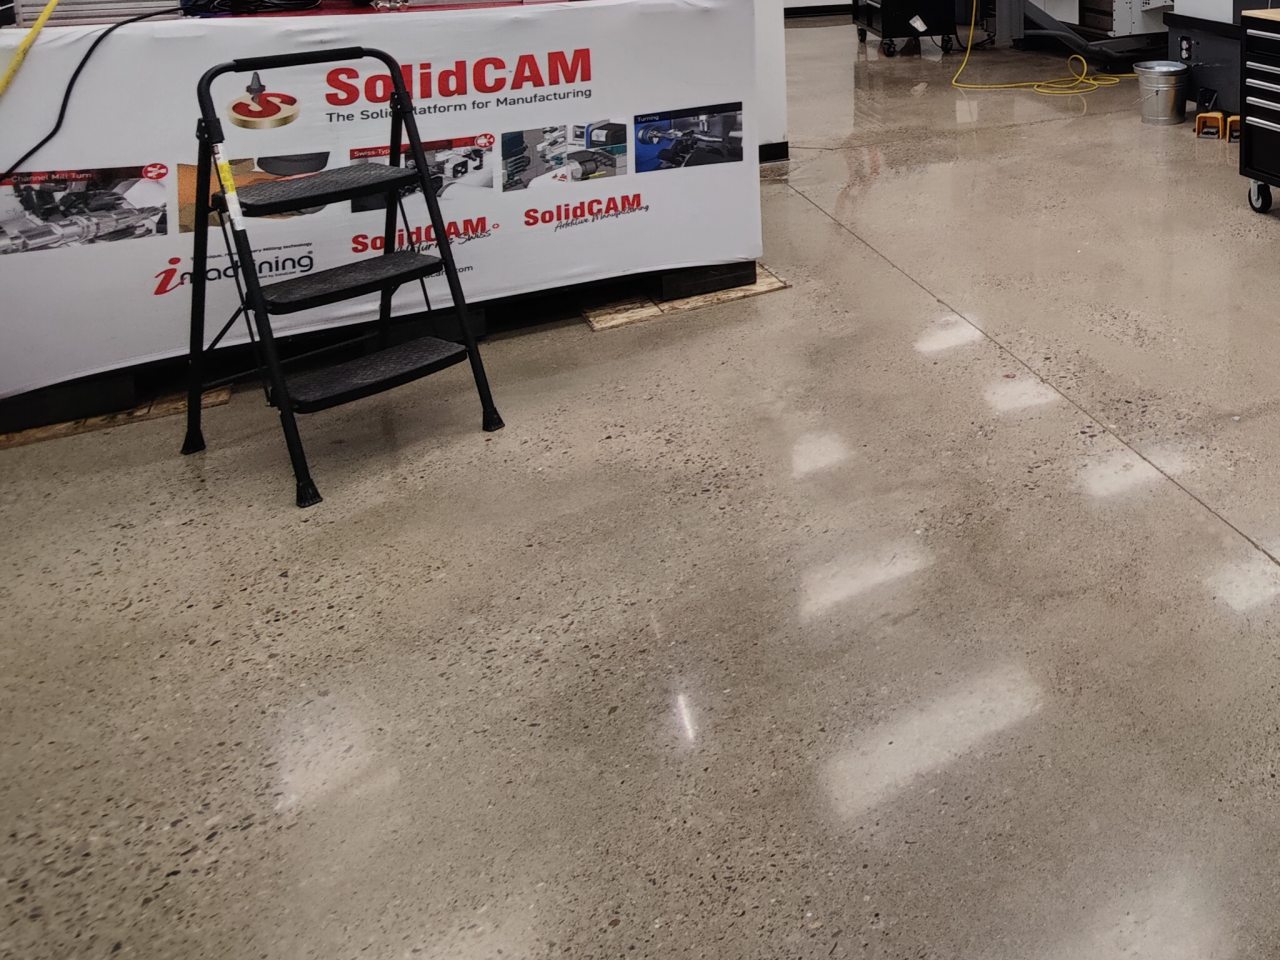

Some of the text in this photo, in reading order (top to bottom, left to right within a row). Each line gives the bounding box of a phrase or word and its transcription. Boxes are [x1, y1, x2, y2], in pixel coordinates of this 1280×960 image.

[325, 48, 591, 106] SolidCAM
[326, 112, 354, 123] The
[413, 100, 467, 116] latform
[472, 99, 491, 111] for
[496, 88, 592, 107] Manufacturing
[636, 114, 660, 122] Turning
[354, 148, 390, 158] Swiss-Typ
[524, 193, 641, 227] SolidCAM
[352, 216, 487, 254] SoidCAM
[458, 229, 492, 245] Swiss
